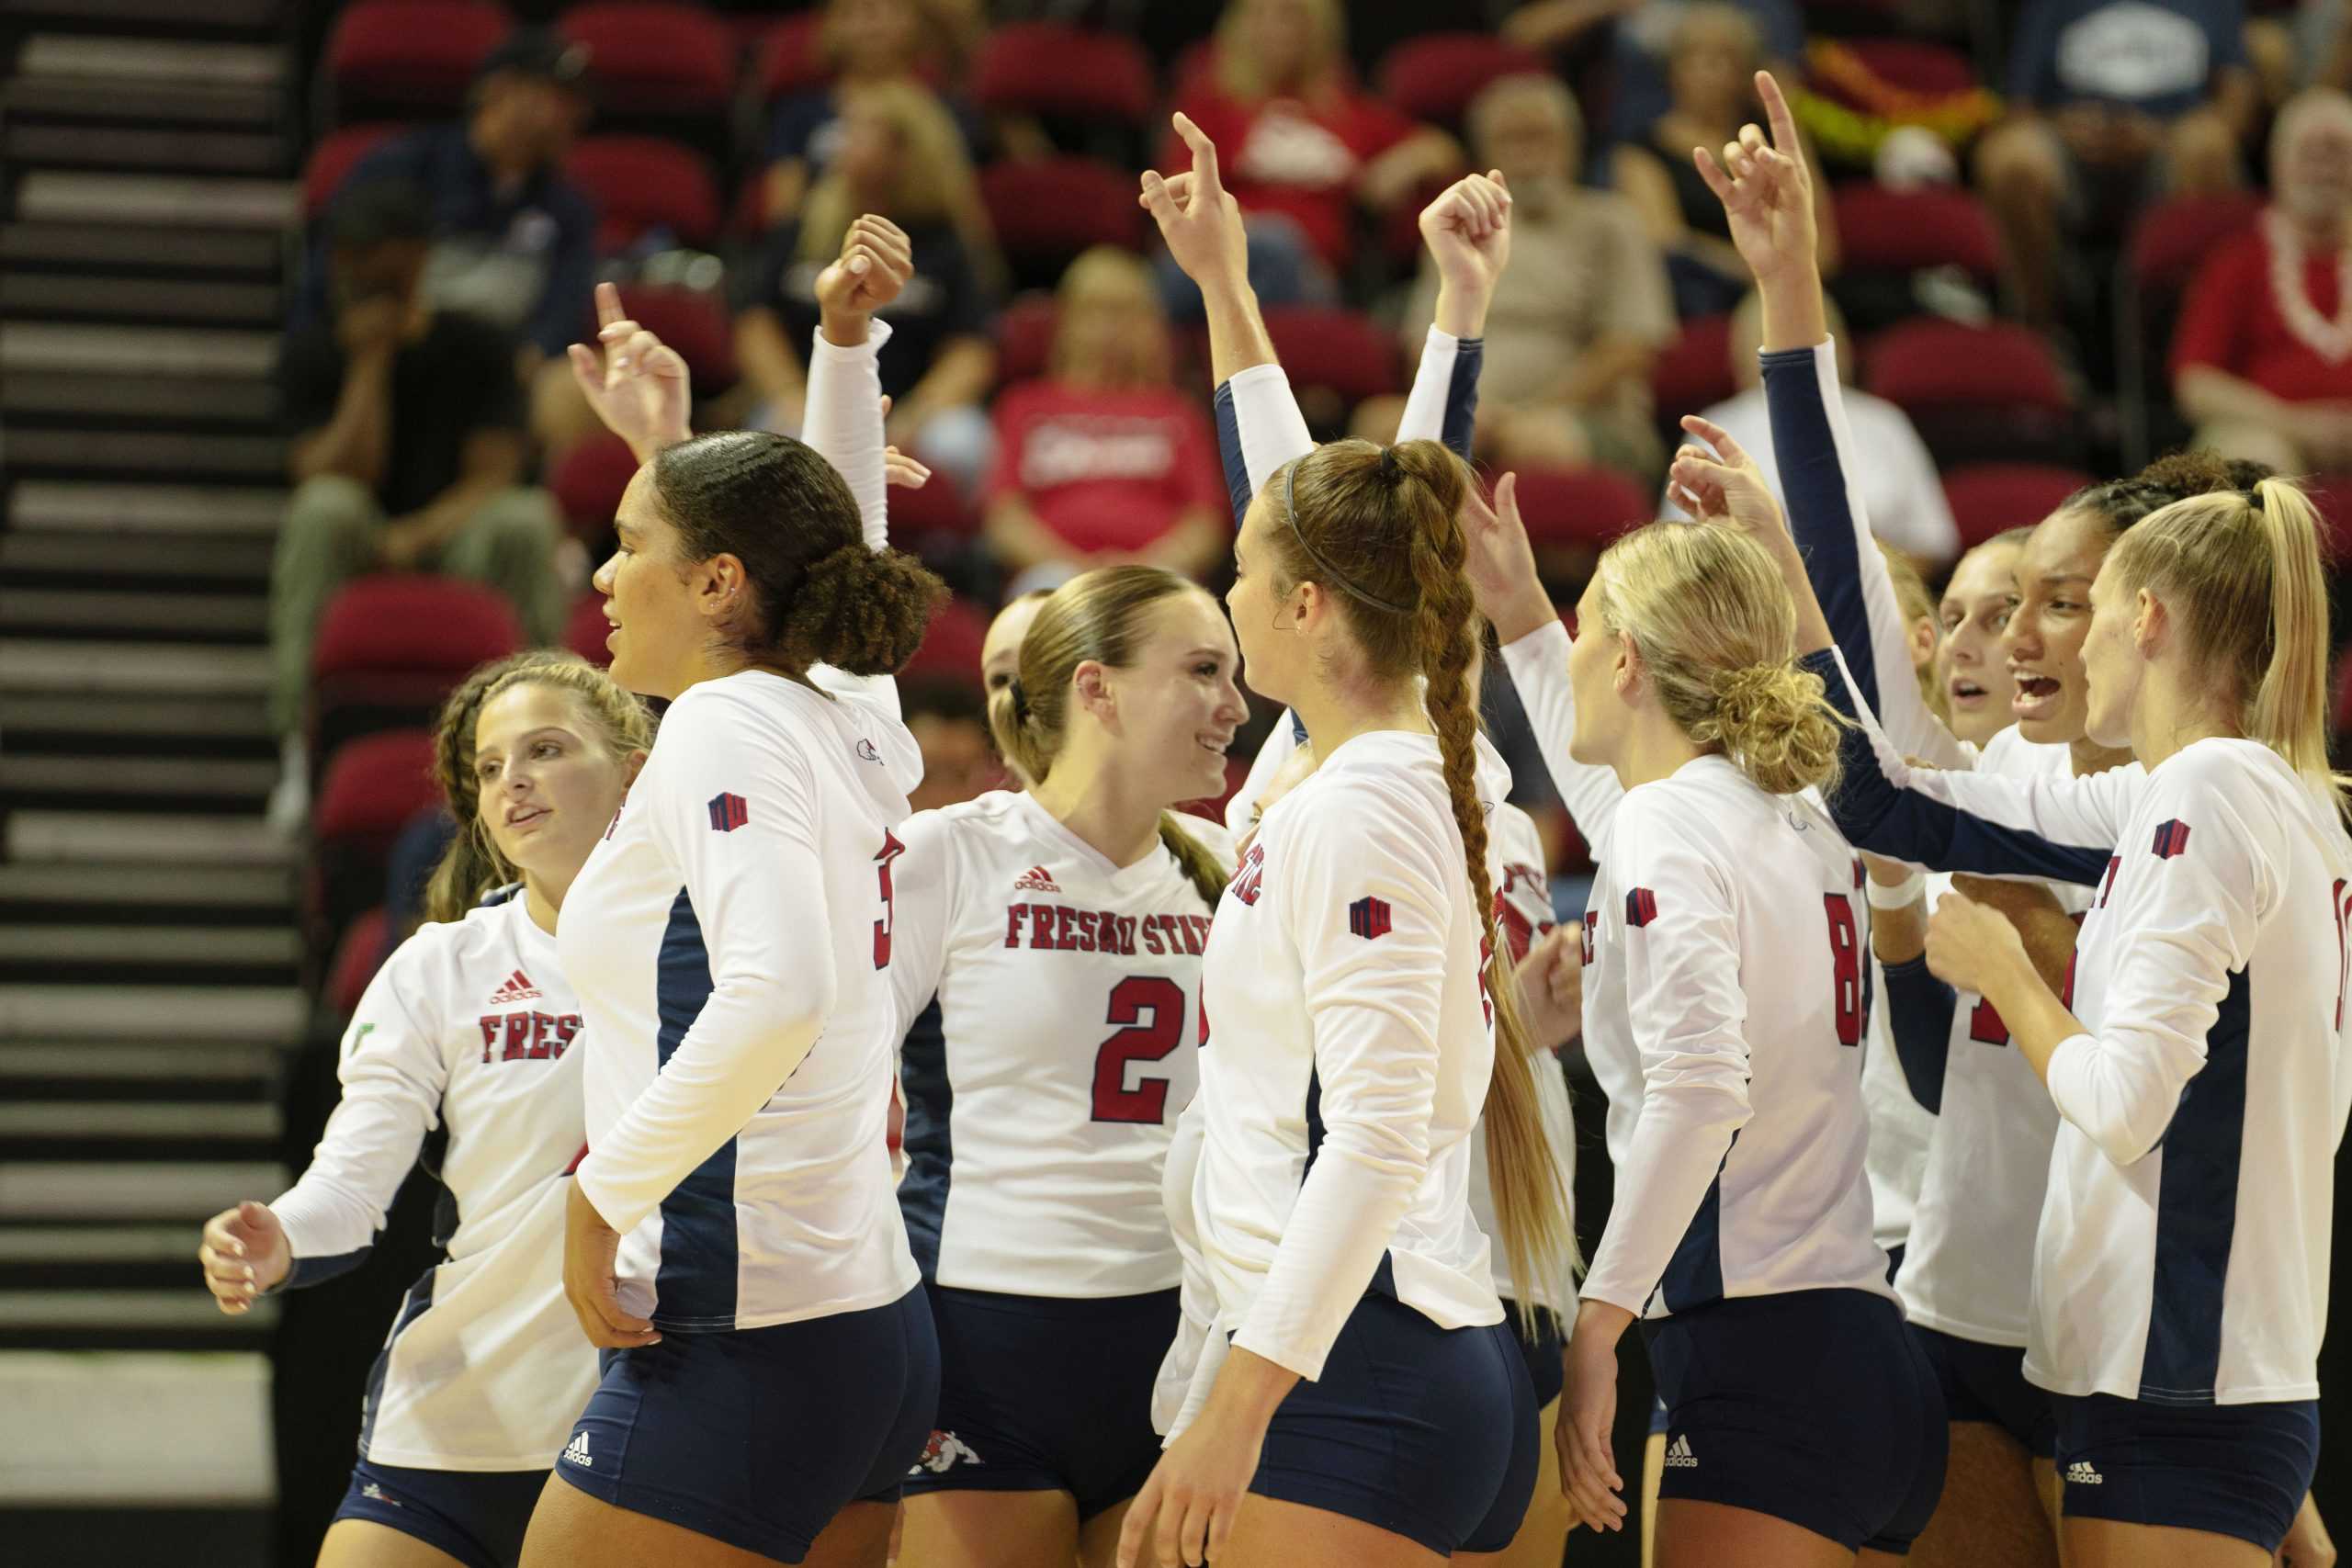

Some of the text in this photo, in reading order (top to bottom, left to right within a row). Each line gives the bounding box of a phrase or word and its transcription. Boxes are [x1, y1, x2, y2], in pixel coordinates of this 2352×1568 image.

[1014, 879, 1062, 894] adidas
[1004, 903, 1136, 955] FRESNO
[490, 989, 544, 1005] adidas
[480, 1010, 585, 1064] FRES
[1091, 976, 1185, 1125] 2
